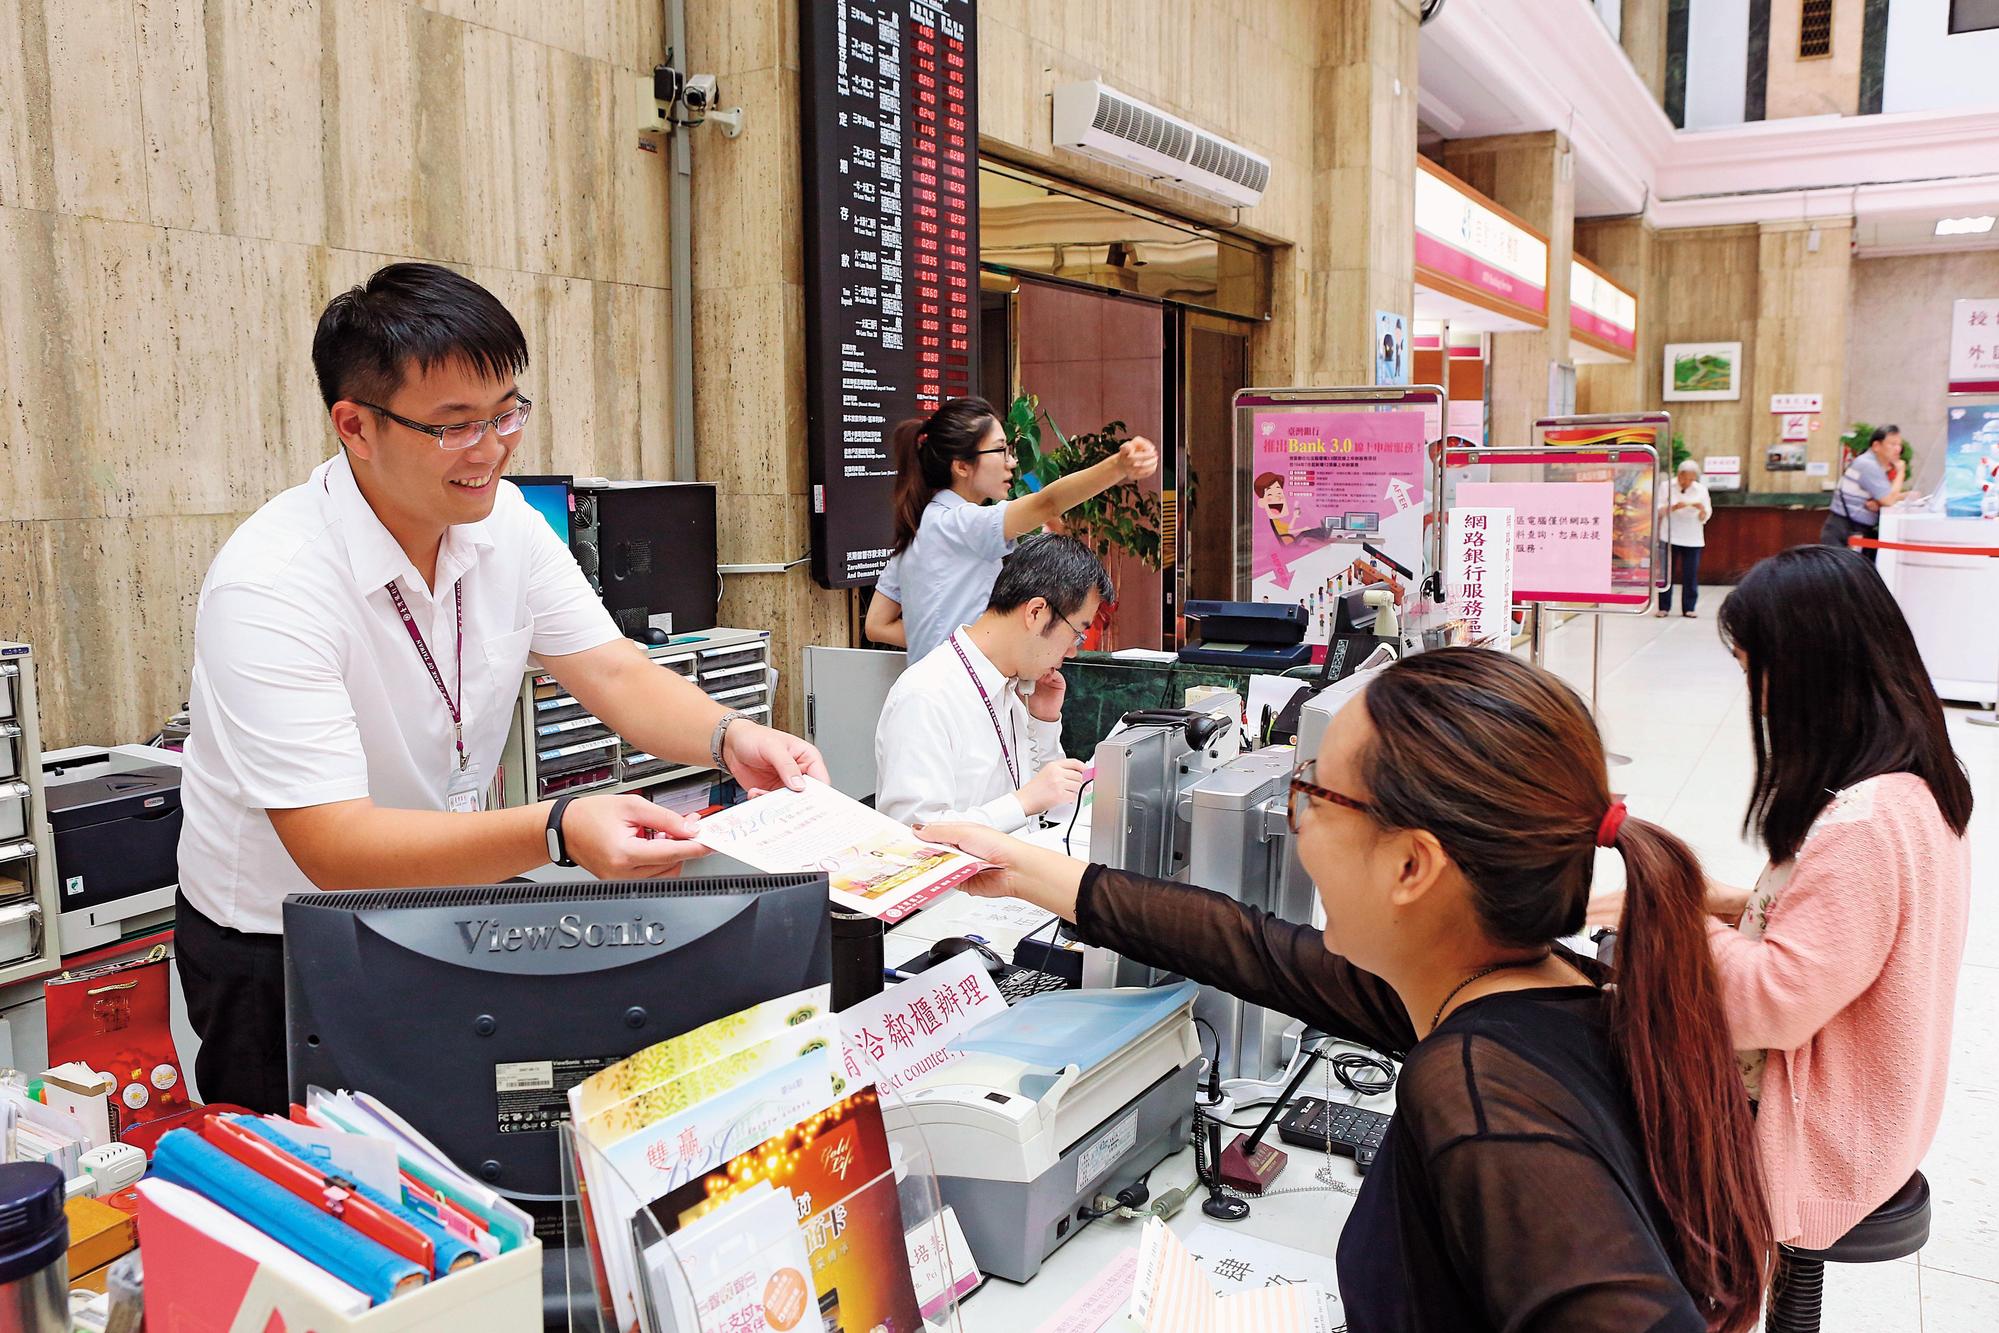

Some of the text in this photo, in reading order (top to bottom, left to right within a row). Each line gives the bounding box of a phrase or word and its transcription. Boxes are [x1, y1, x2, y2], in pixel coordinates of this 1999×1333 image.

[1288, 439, 1326, 452] Bank
[1330, 438, 1352, 452] 3.0
[1392, 484, 1409, 511] AFTER
[1461, 514, 1487, 633] 網路銀行服務區
[456, 914, 666, 955] ViewSonic
[904, 1047, 955, 1082] counter,
